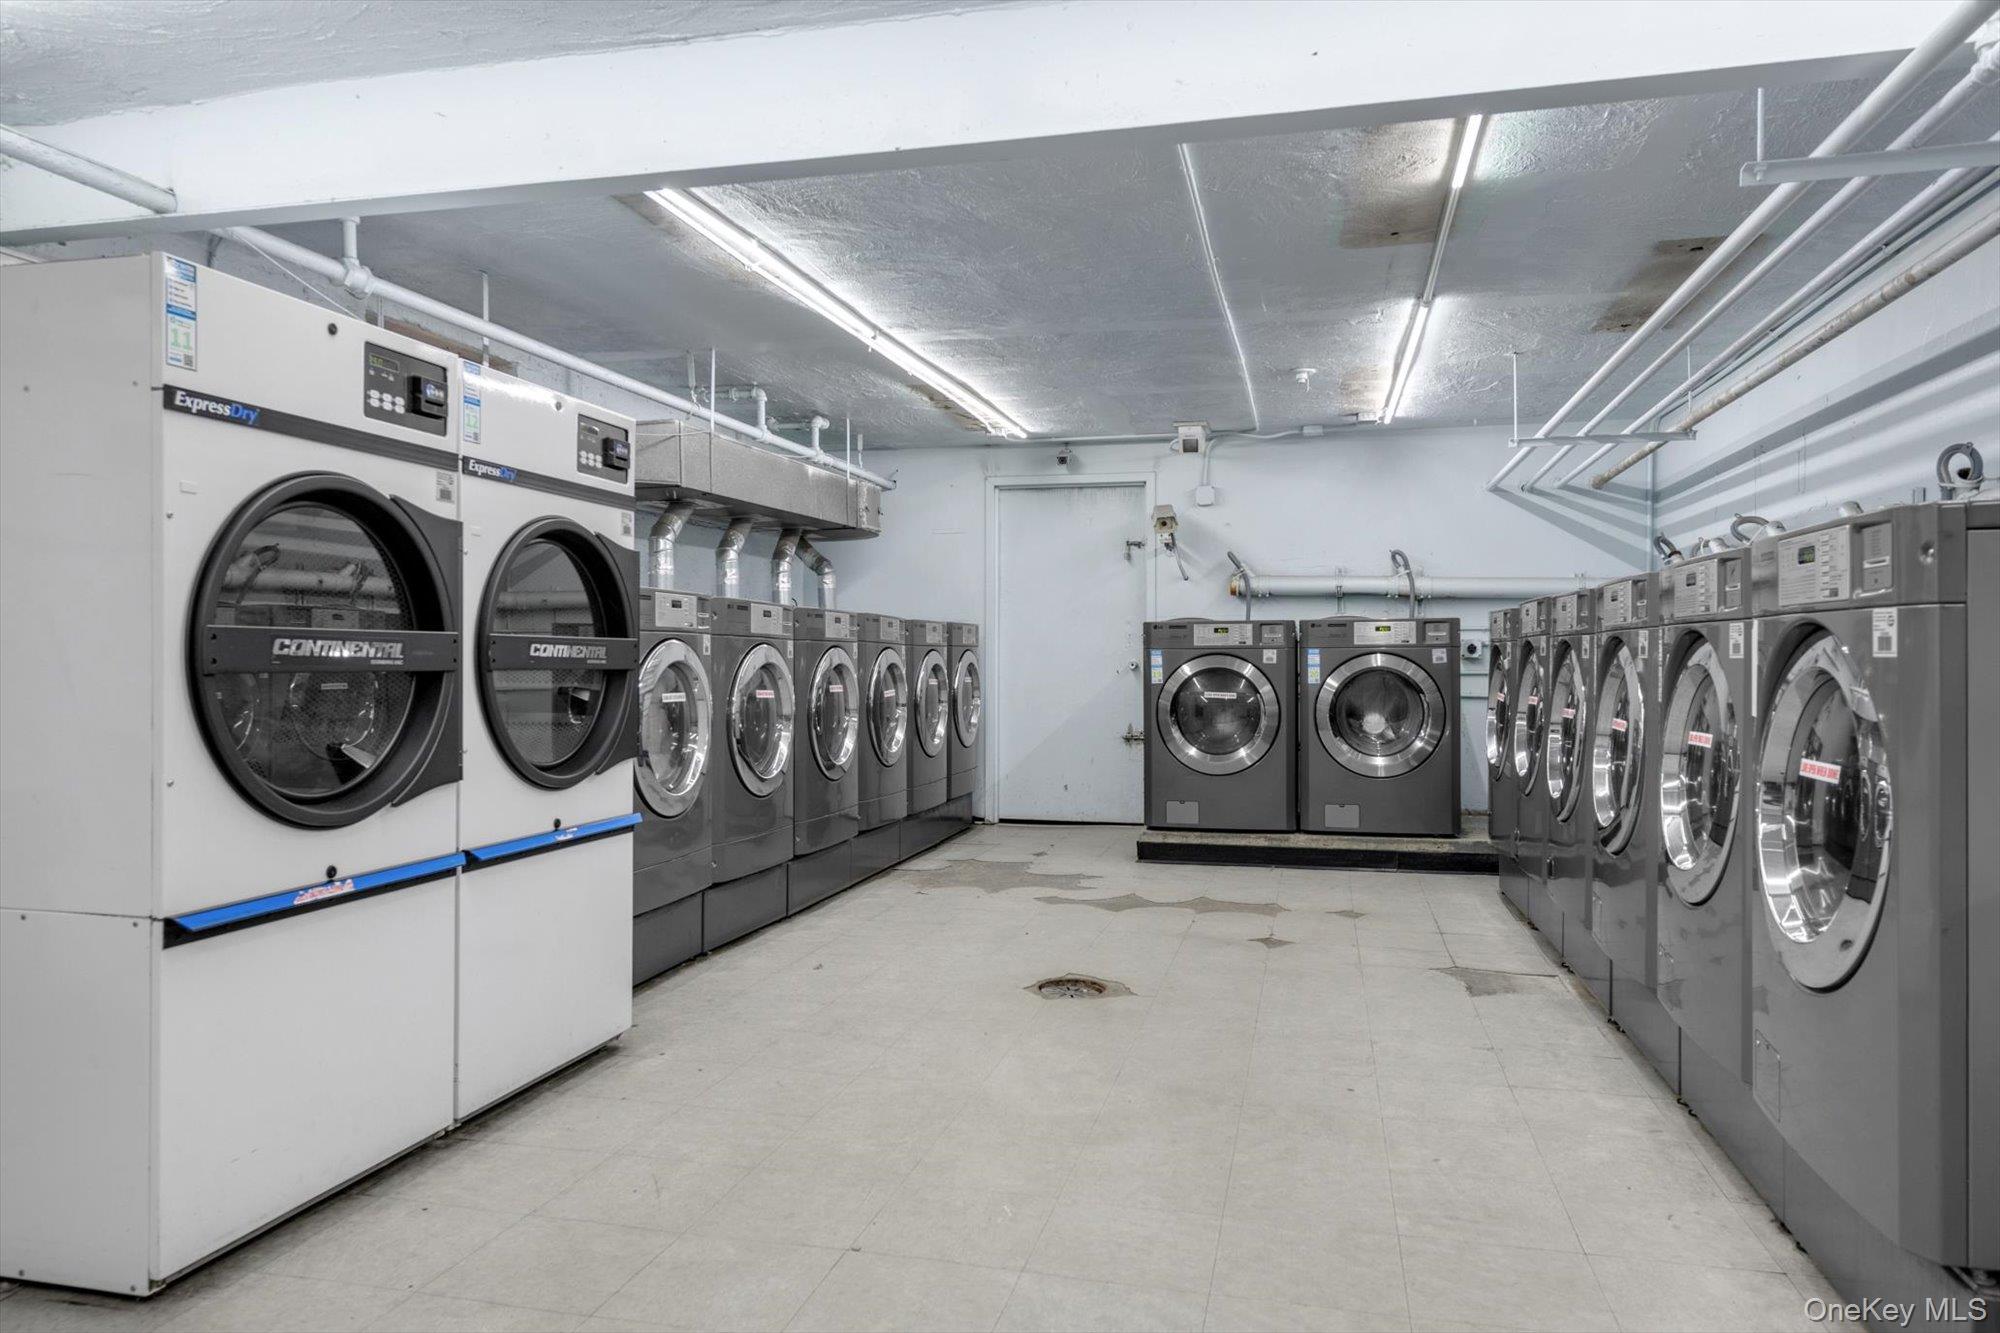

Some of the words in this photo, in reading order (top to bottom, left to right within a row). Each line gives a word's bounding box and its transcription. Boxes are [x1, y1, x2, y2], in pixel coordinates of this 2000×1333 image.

[171, 328, 193, 351] 11
[174, 390, 258, 425] ExpressDry
[469, 459, 518, 481] ExpressDry
[272, 638, 404, 658] CONTINENTAL
[529, 643, 607, 659] CONTINENTAL
